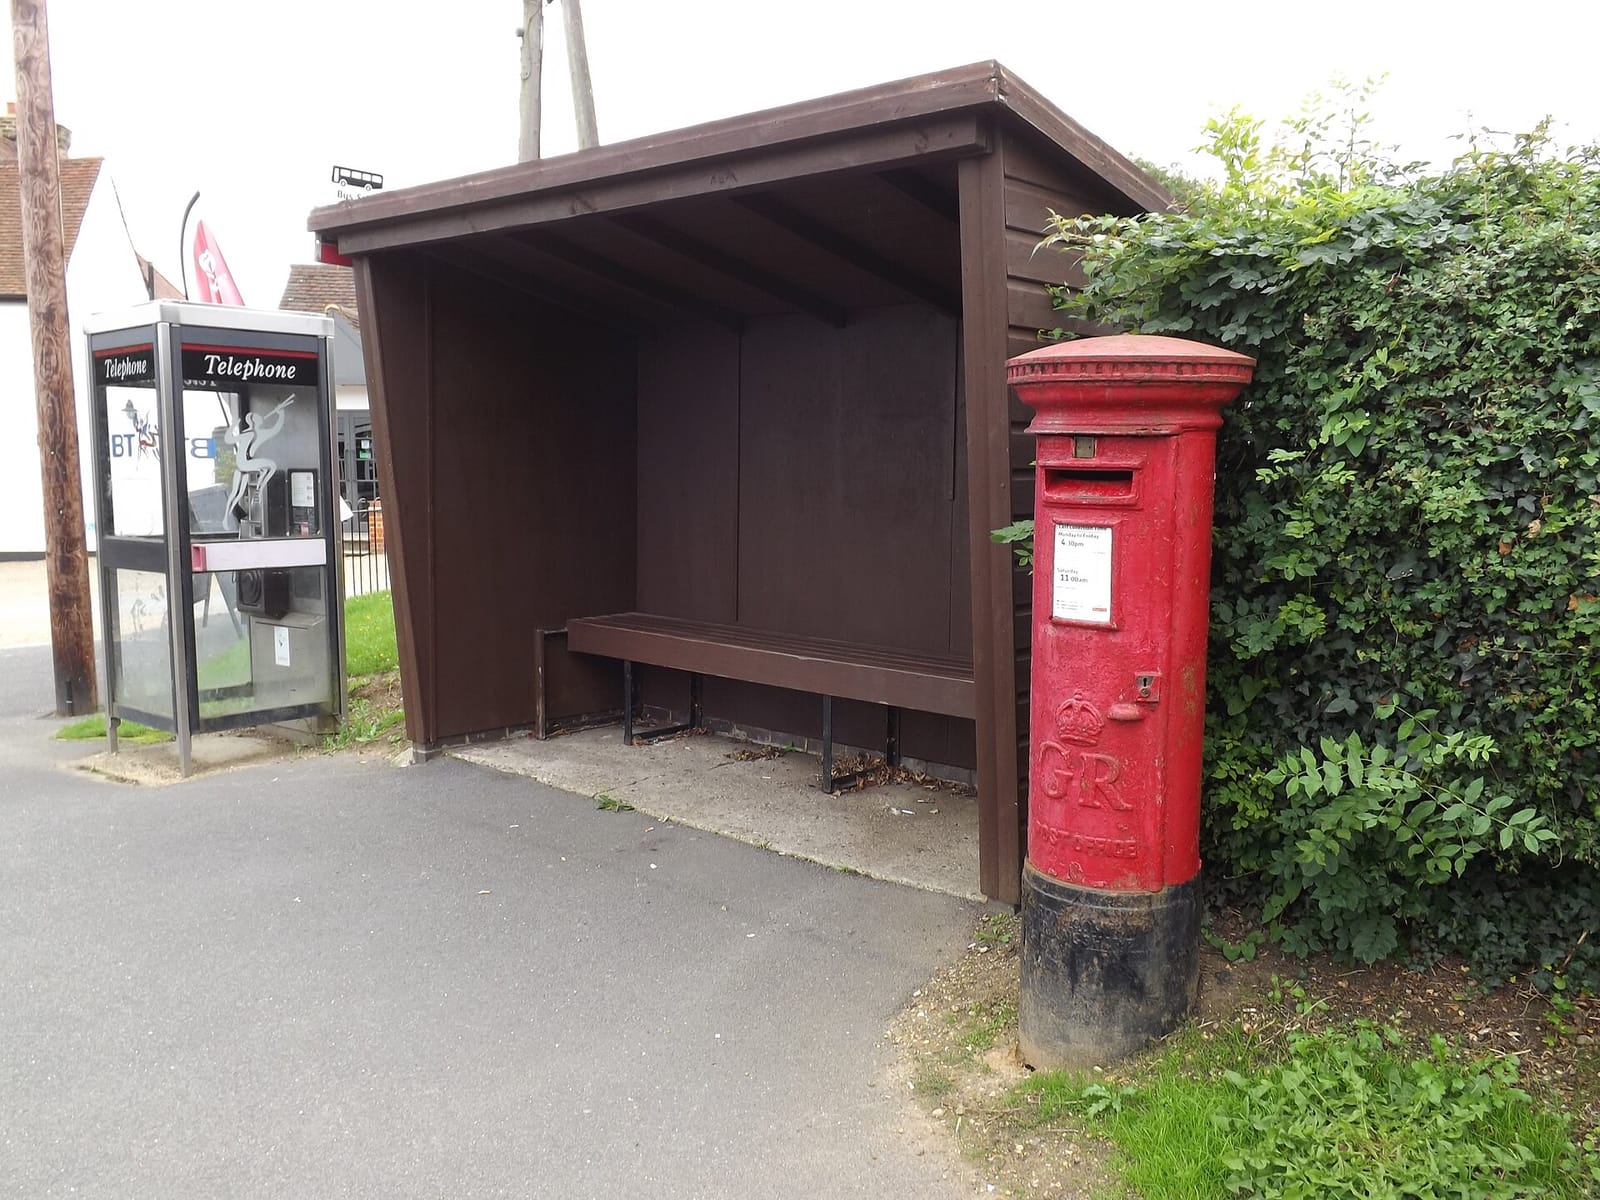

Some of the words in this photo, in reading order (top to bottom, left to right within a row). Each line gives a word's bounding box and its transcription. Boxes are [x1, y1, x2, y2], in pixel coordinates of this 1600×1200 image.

[105, 356, 147, 380] Telephone
[204, 355, 296, 380] Telephone
[112, 434, 135, 457] BT
